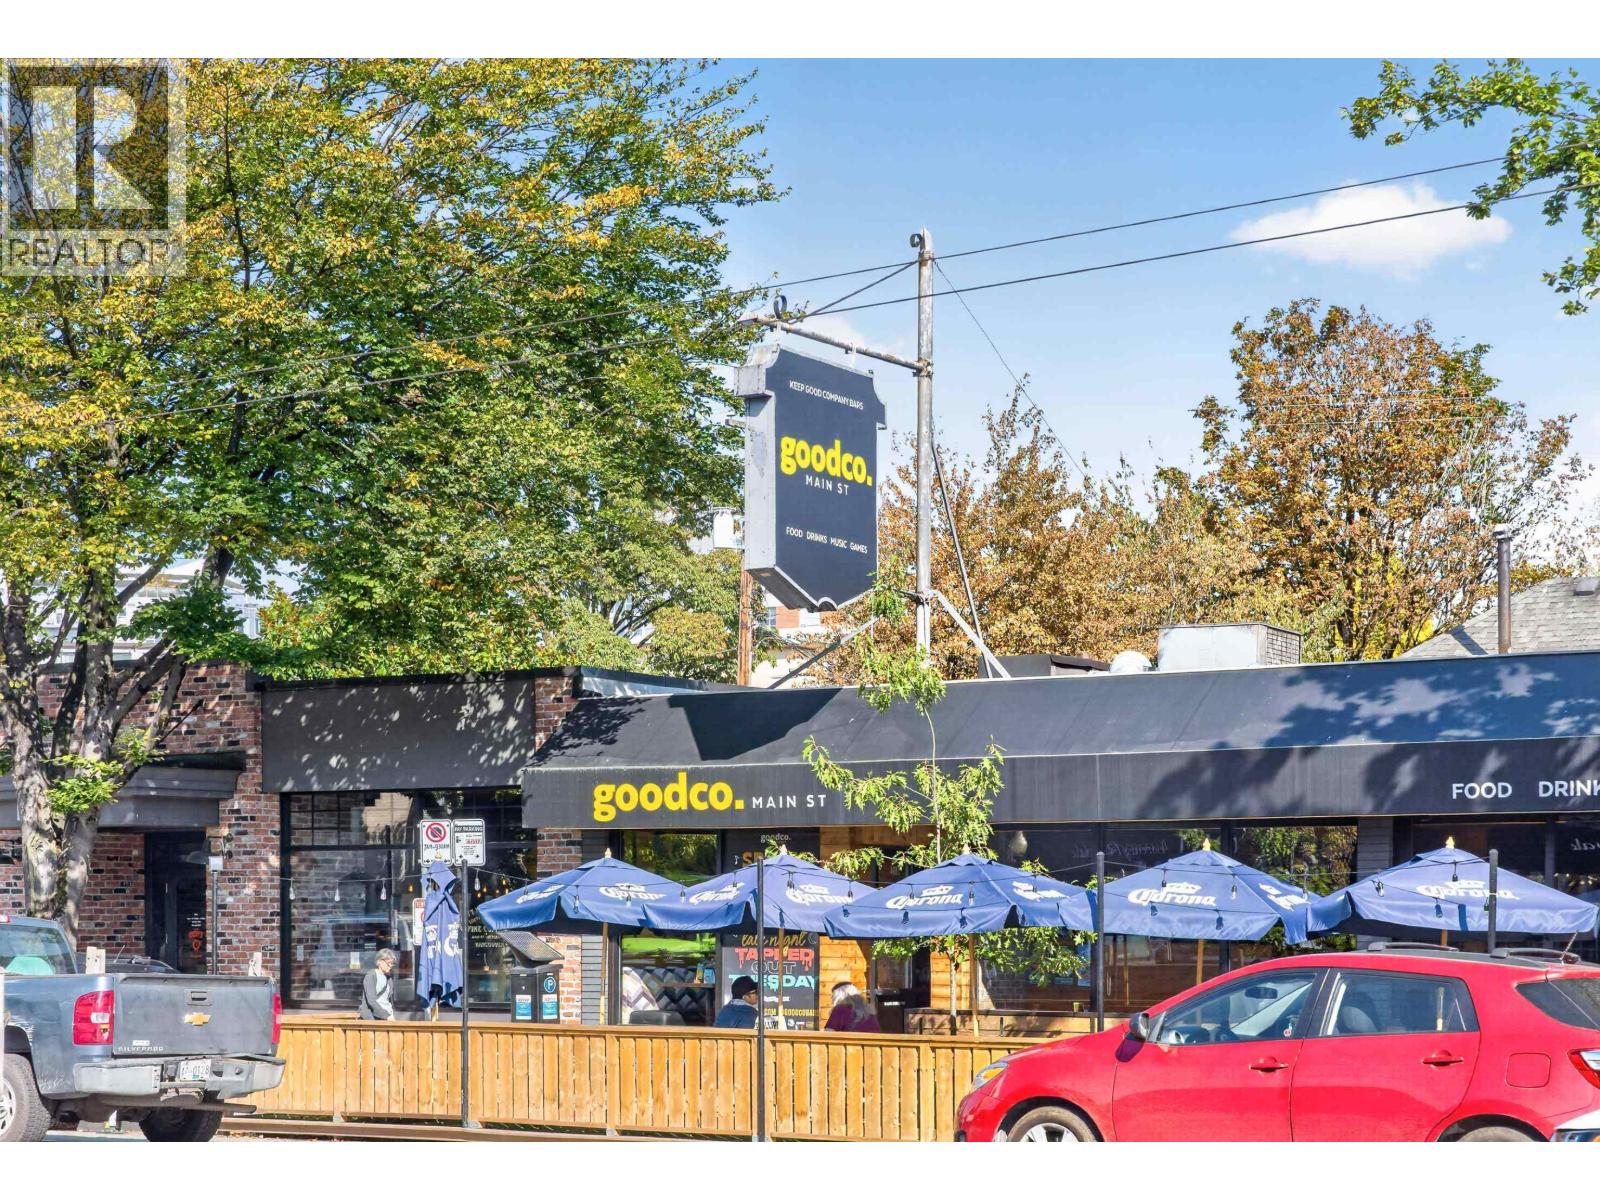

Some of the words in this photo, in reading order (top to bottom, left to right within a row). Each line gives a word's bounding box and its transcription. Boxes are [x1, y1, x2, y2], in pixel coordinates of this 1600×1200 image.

[789, 380, 805, 392] KEEP
[805, 385, 822, 397] GOOD
[822, 390, 849, 406] COMPANY
[849, 398, 864, 410] BARS
[780, 436, 873, 486] goodco.
[805, 474, 833, 491] MAIN
[837, 483, 849, 495] ST
[785, 526, 804, 538] FOOD
[806, 530, 828, 544] DRINKS
[830, 537, 848, 549] MUSIC
[849, 542, 868, 554] GAMES
[593, 771, 744, 822] goodco.
[752, 795, 797, 809] MAIN
[806, 794, 827, 808] ST
[1452, 781, 1513, 799] FOOD
[885, 893, 963, 910] Corona
[1128, 888, 1217, 907] Corona
